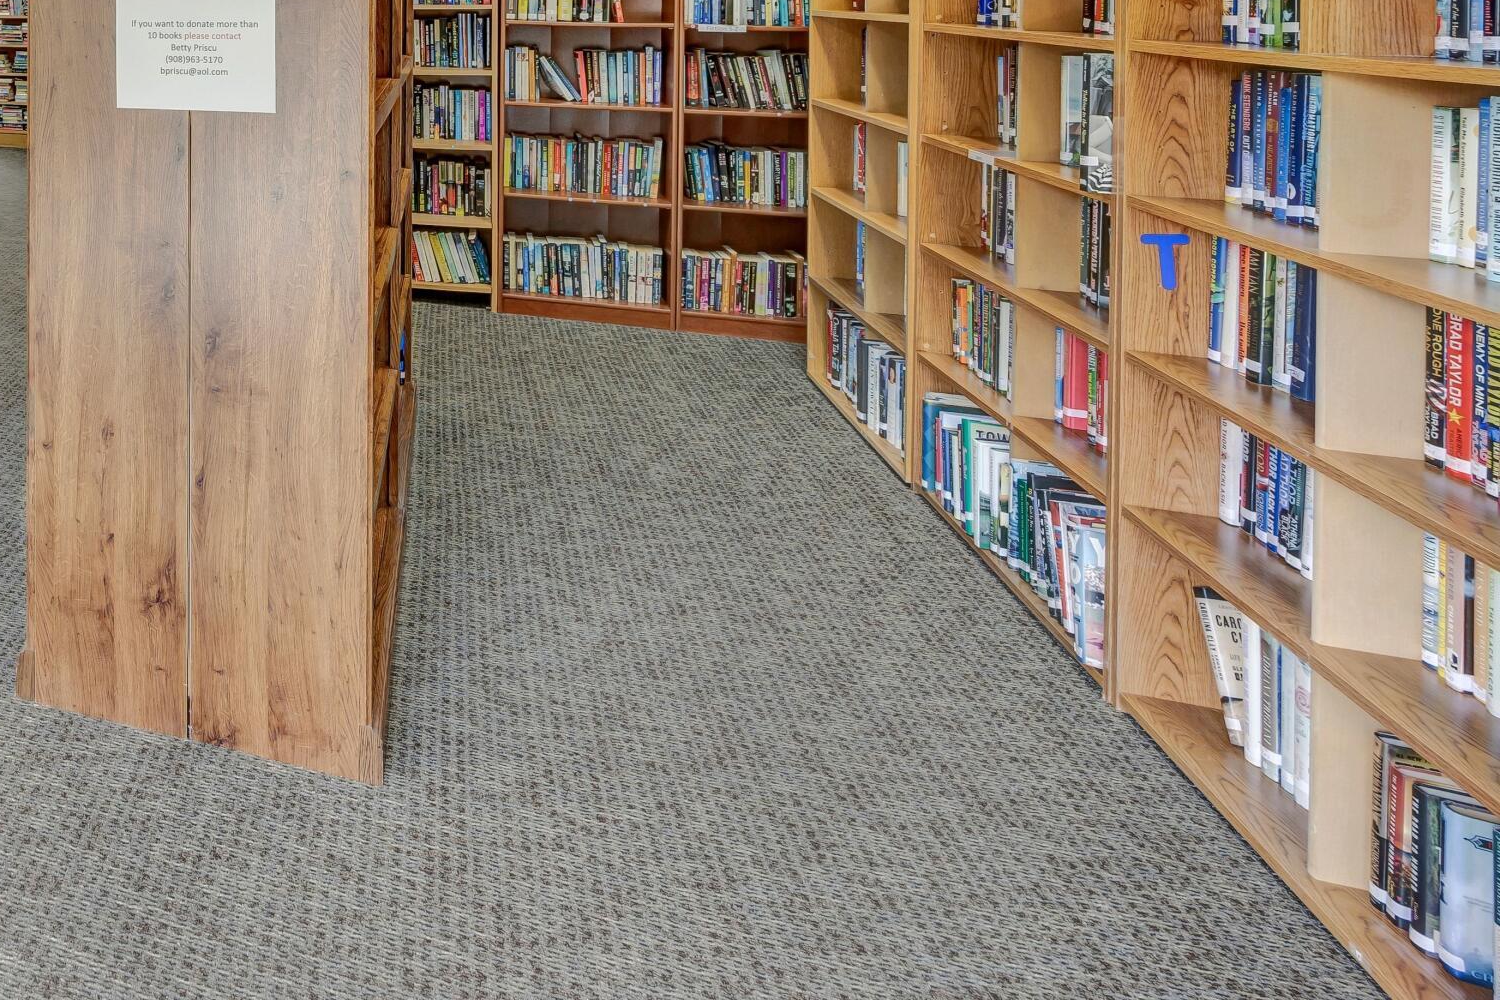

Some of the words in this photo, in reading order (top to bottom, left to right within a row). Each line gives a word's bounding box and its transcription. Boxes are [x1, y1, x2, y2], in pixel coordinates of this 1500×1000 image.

[132, 20, 136, 28] If
[187, 20, 215, 28] donate
[240, 20, 259, 28] than
[184, 32, 209, 40] please
[166, 55, 223, 64] (908)963-5170
[171, 44, 191, 52] Betty
[160, 67, 228, 76] bpriscu@aol.com
[1243, 95, 1251, 131] STEINBERG
[1307, 92, 1317, 153] INFORMATIONIST
[1230, 141, 1236, 153] OF
[1243, 135, 1251, 150] OUT
[1480, 133, 1489, 149] THE
[1479, 152, 1488, 186] COUNTRY
[1140, 234, 1190, 291] T
[1250, 250, 1260, 274] AMY
[1249, 274, 1260, 295] TAN
[1432, 334, 1442, 378] ROUGH
[1487, 328, 1500, 367] BRAD
[1449, 353, 1462, 408] TAYLOR
[1475, 364, 1486, 383] OF
[1475, 385, 1485, 418] MINE
[1487, 370, 1500, 426] TAYLOR
[1430, 412, 1439, 439] BRAD
[1268, 446, 1278, 481] THOR
[1268, 481, 1276, 513] BLACK
[1199, 602, 1212, 633] CAROLINA
[1205, 634, 1216, 652] CLAY
[1412, 796, 1420, 815] THE
[1411, 817, 1419, 839] ROAD
[1410, 857, 1419, 893] MURDER
